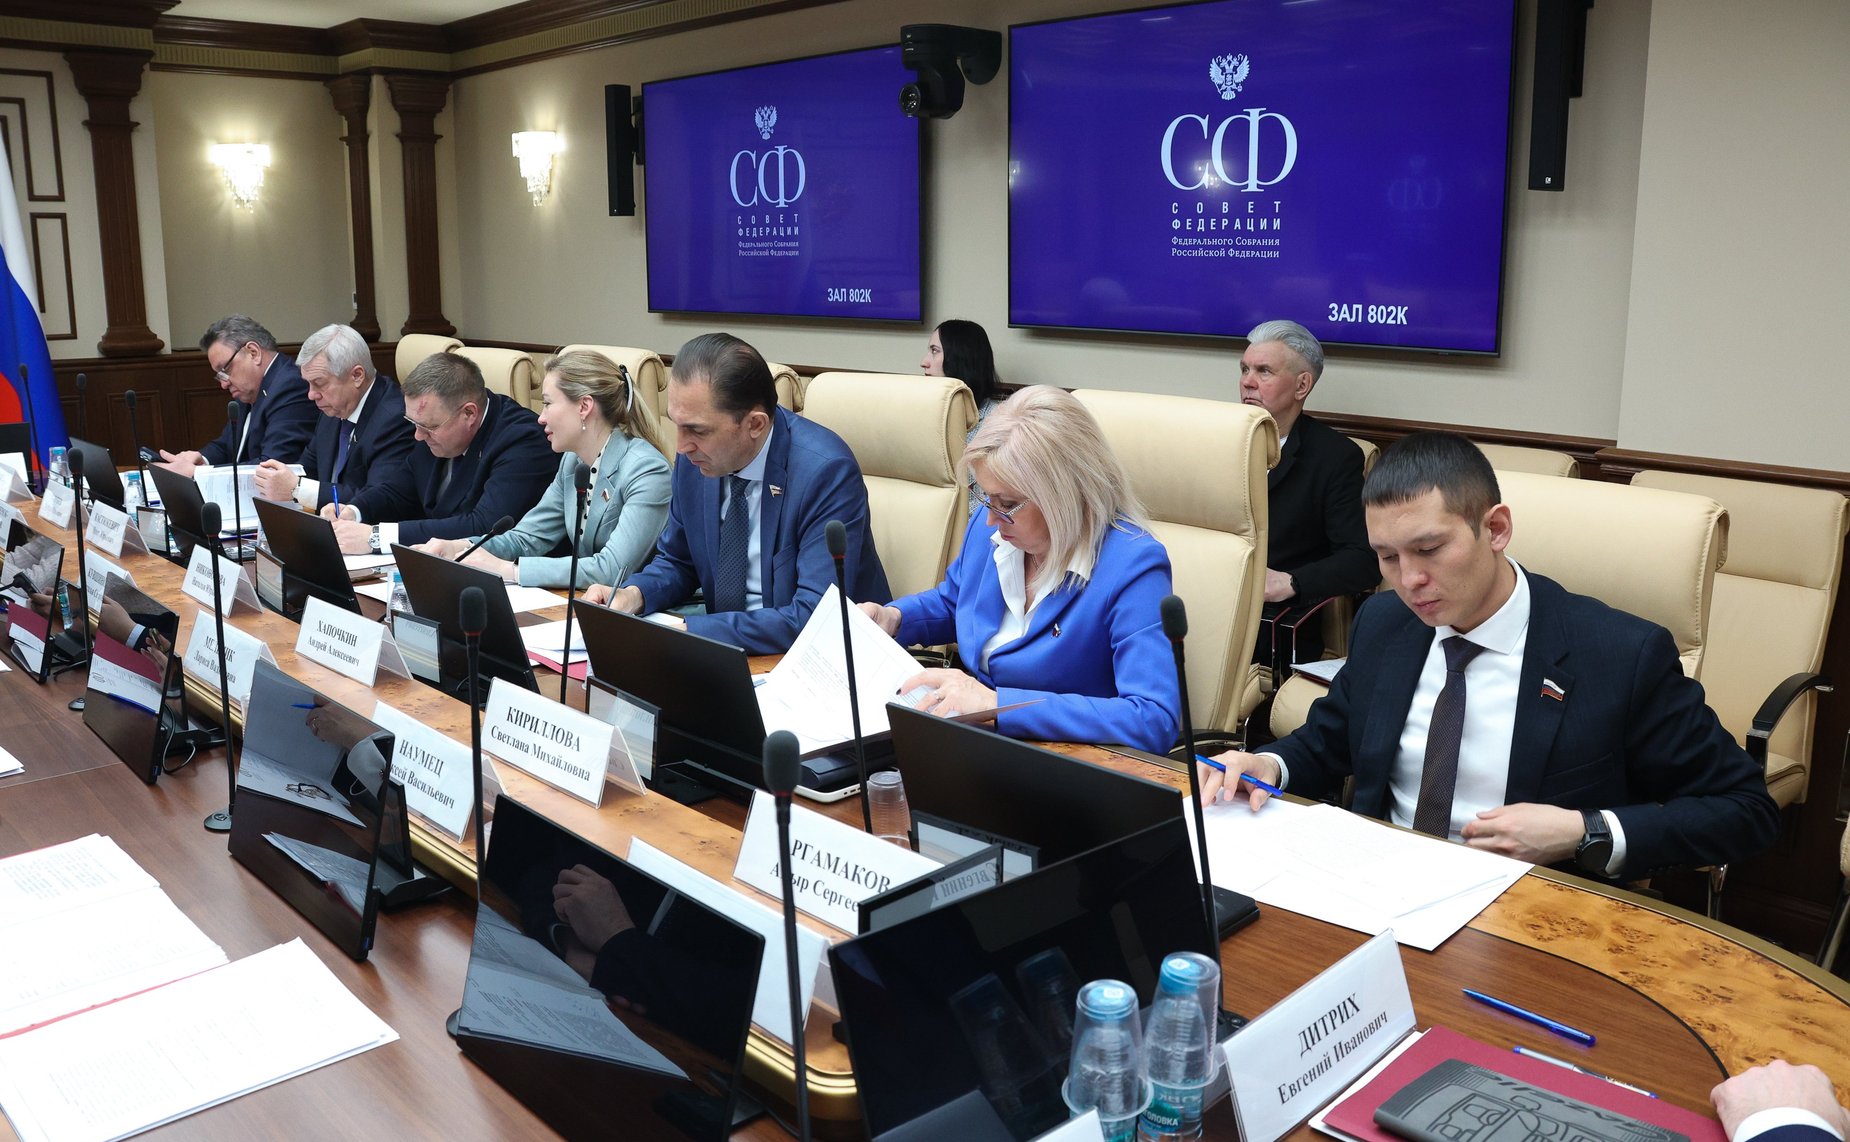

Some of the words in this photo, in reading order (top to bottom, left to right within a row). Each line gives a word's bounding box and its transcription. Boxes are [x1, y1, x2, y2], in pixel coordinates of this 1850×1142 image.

[1160, 107, 1298, 192] СФ
[730, 145, 806, 208] СФ
[737, 213, 799, 225] СОВЕТ
[1172, 201, 1281, 214] СОВЕТ
[1172, 218, 1281, 232] ФЕДЕРАЦИИ
[737, 226, 799, 238] ФЕДЕРАЦИИ
[827, 287, 847, 302] ЗАЛ
[849, 288, 872, 303] 802К
[1328, 302, 1363, 323] ЗАЛ
[1367, 304, 1409, 325] 802К
[308, 635, 327, 652] Андрей
[327, 644, 360, 667] Алексеевич
[316, 620, 358, 647] ХАПОЧКИН
[506, 706, 580, 752] КИРИЛЛОВА
[399, 739, 444, 778] НАУМЕЦ
[491, 725, 530, 754] Светлана
[531, 743, 591, 782] Михайловна
[390, 763, 408, 781] ксей
[407, 770, 455, 809] Васильевич
[770, 861, 809, 893] Аыр
[813, 879, 859, 912] Сергее
[790, 839, 891, 893] РГАМАКОВ
[1298, 992, 1361, 1060] ДИТРИХ
[1277, 1051, 1333, 1105] Евгений
[1333, 1010, 1388, 1063] Иванович
